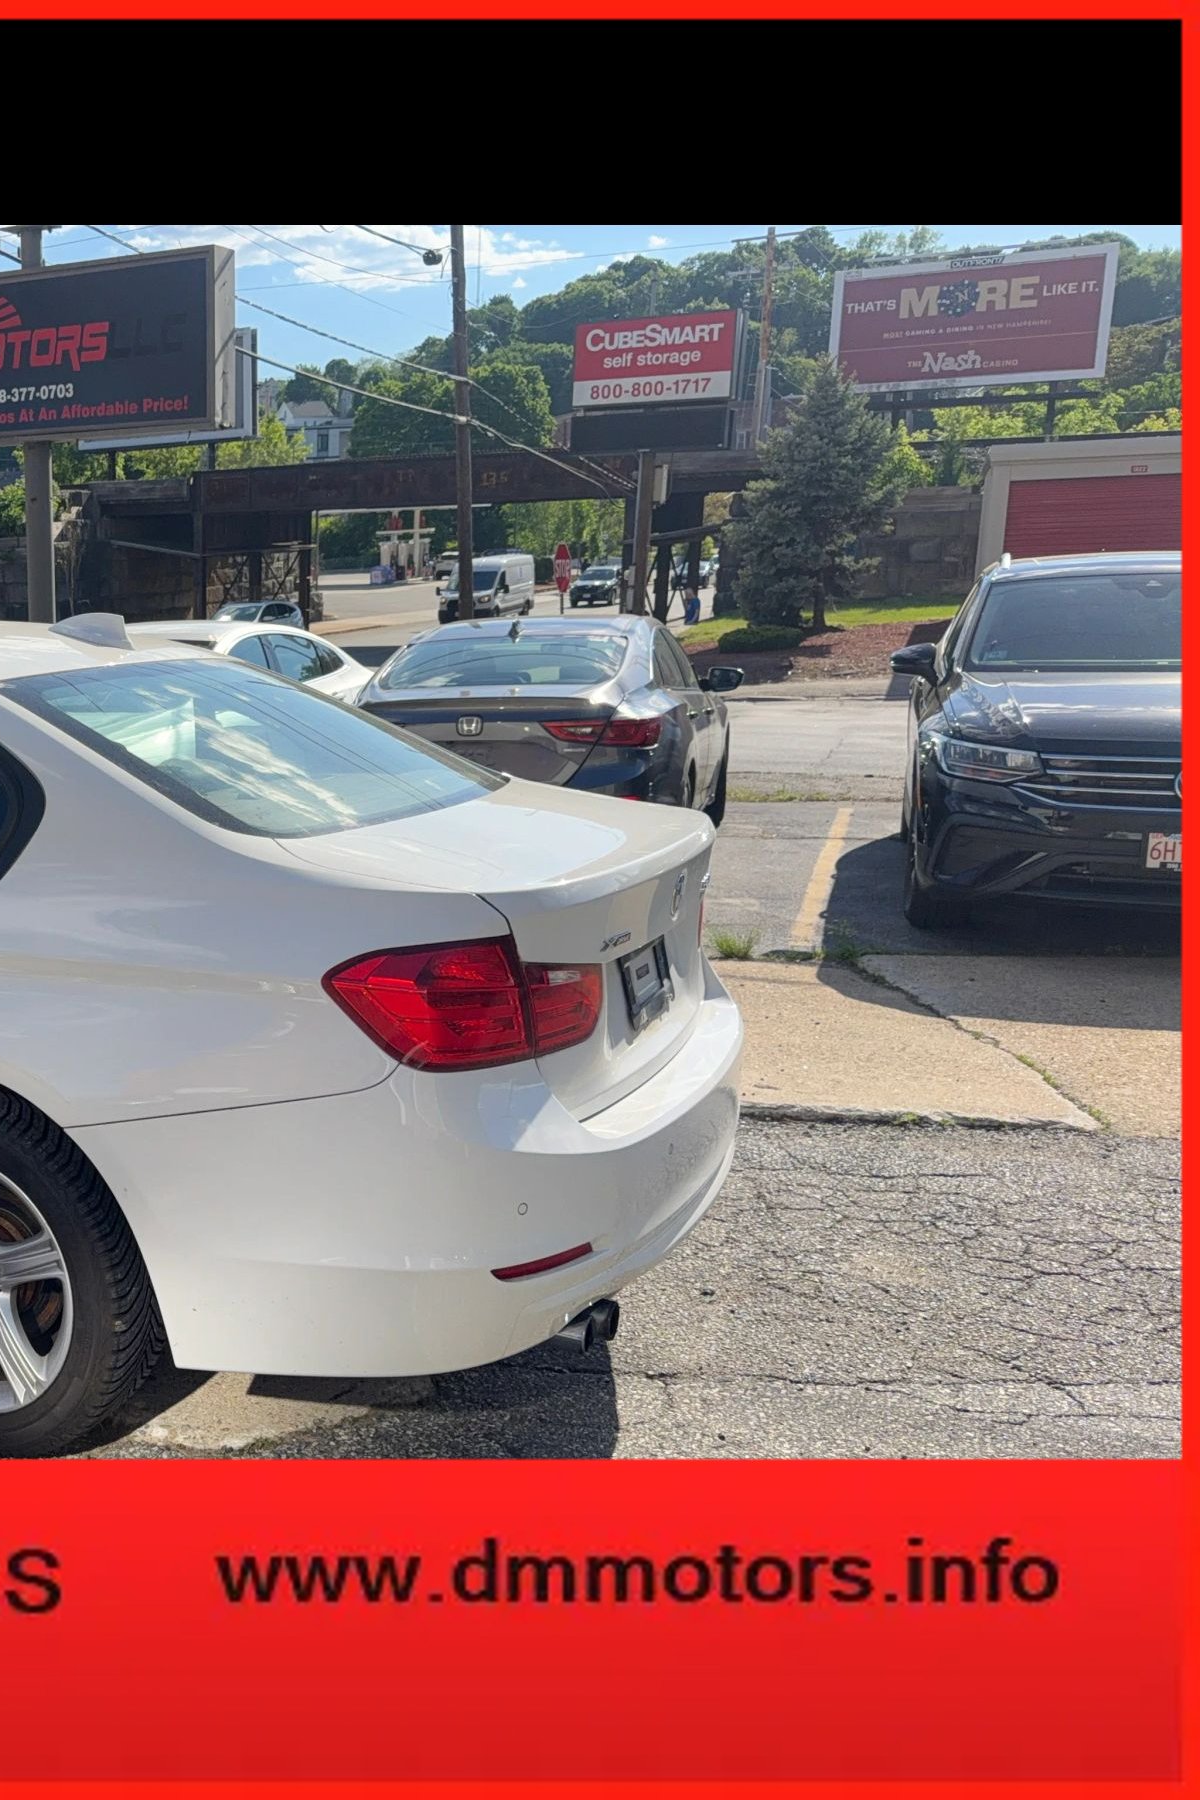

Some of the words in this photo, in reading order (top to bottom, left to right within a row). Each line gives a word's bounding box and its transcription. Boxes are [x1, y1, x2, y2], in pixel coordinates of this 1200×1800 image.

[845, 299, 896, 315] THAT'S
[899, 275, 1041, 320] MORE
[1042, 283, 1078, 297] LIKE
[1081, 280, 1099, 293] IT.
[603, 353, 632, 368] self
[636, 350, 701, 367] storage
[921, 350, 982, 373] Nash
[982, 358, 1019, 368] CASINO
[590, 377, 712, 400] 800-800-1717
[19, 408, 34, 422] At
[38, 407, 57, 421] An
[61, 401, 138, 419] Affordable
[143, 395, 189, 413] Price!
[555, 559, 570, 578] STOP
[1150, 841, 1183, 861] 6H
